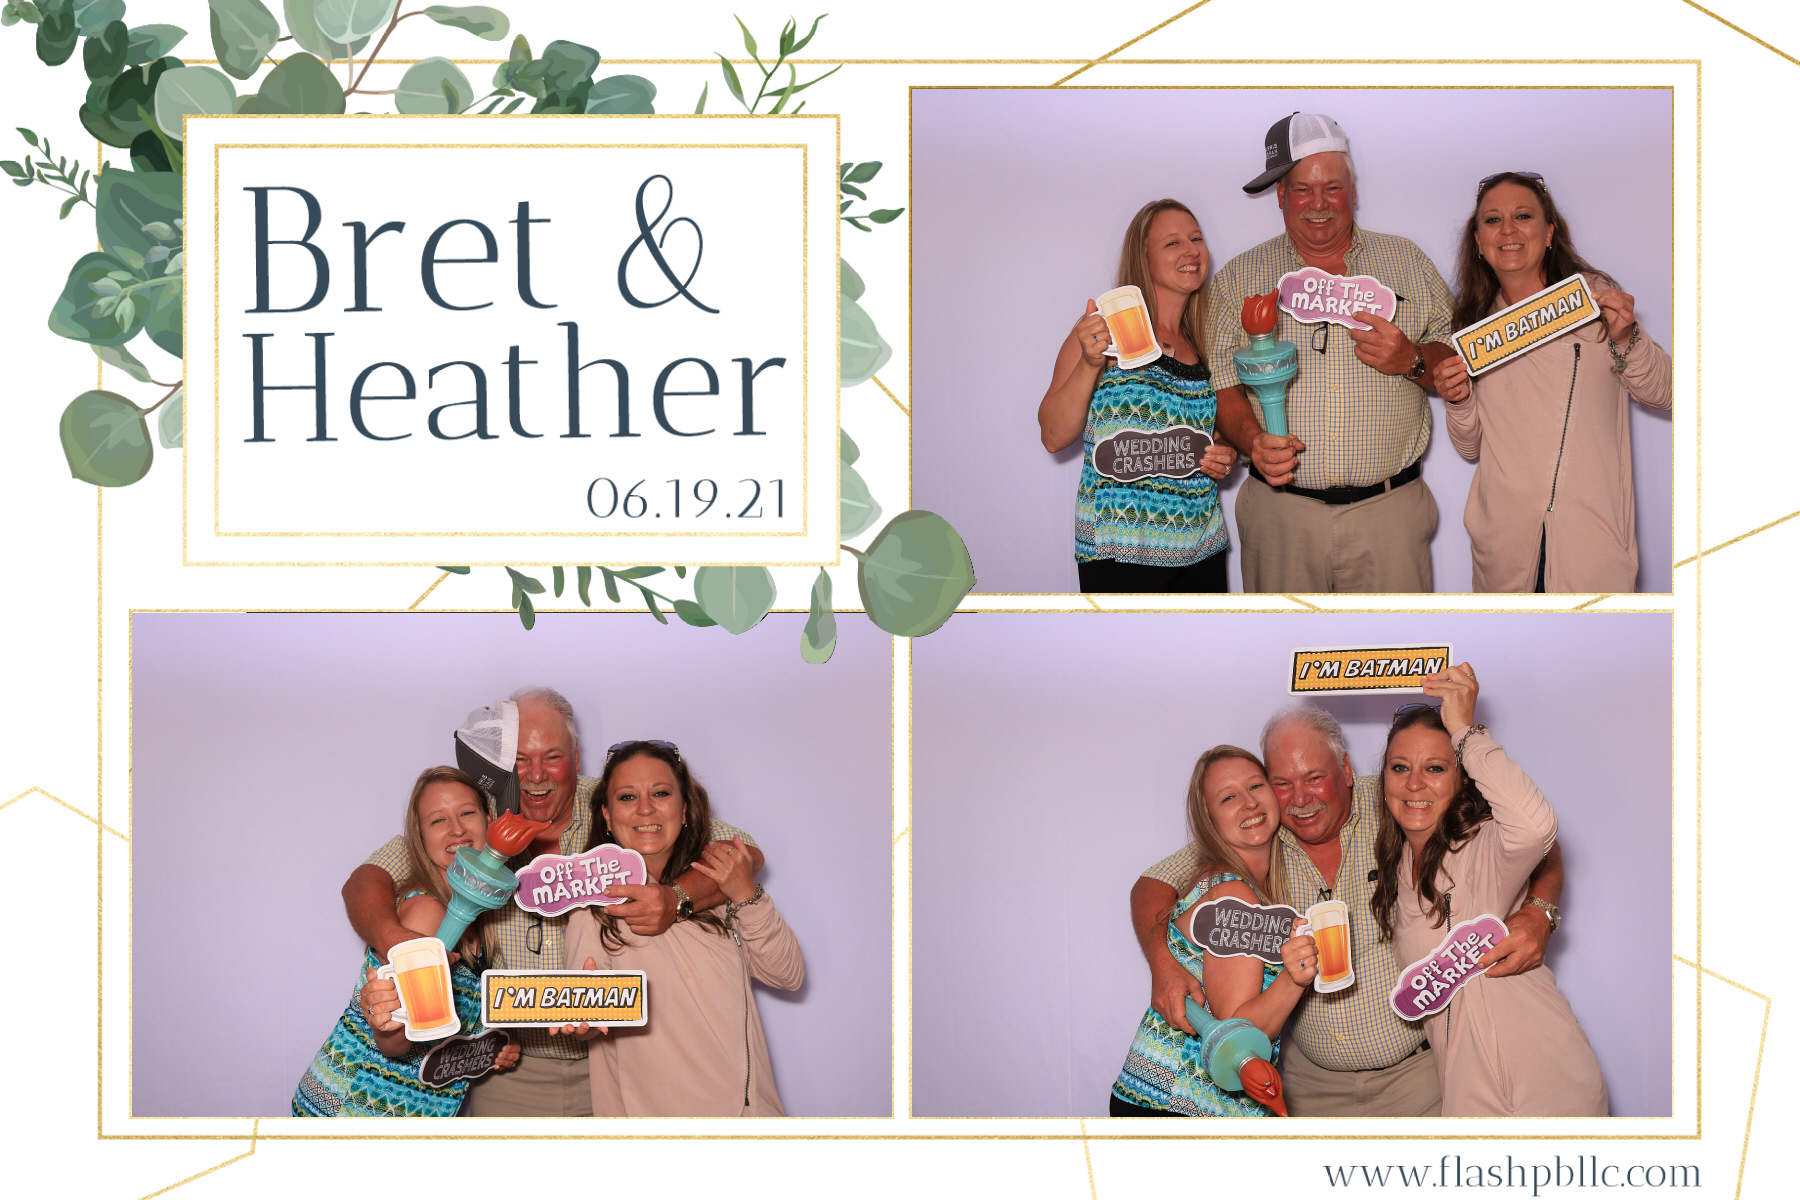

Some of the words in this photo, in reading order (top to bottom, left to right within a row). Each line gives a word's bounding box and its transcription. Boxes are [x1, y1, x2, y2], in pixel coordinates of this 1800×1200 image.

[1304, 277, 1335, 296] Off
[1340, 282, 1375, 302] The
[1469, 330, 1504, 360] I'M
[1505, 288, 1584, 342] BATMAN
[1113, 436, 1191, 456] WEDDING
[1112, 453, 1195, 473] CRASHERS
[1299, 660, 1341, 680] I'M
[1344, 657, 1445, 677] BATMAN
[540, 861, 573, 883] Off
[579, 856, 621, 877] The
[1215, 907, 1292, 935] WEDDING
[1411, 960, 1443, 990] Off
[1441, 932, 1481, 962] The
[493, 986, 537, 1009] I'M
[540, 987, 639, 1009] BATMAN
[440, 1038, 496, 1064] WEDDING
[433, 1053, 494, 1080] CRASHERS
